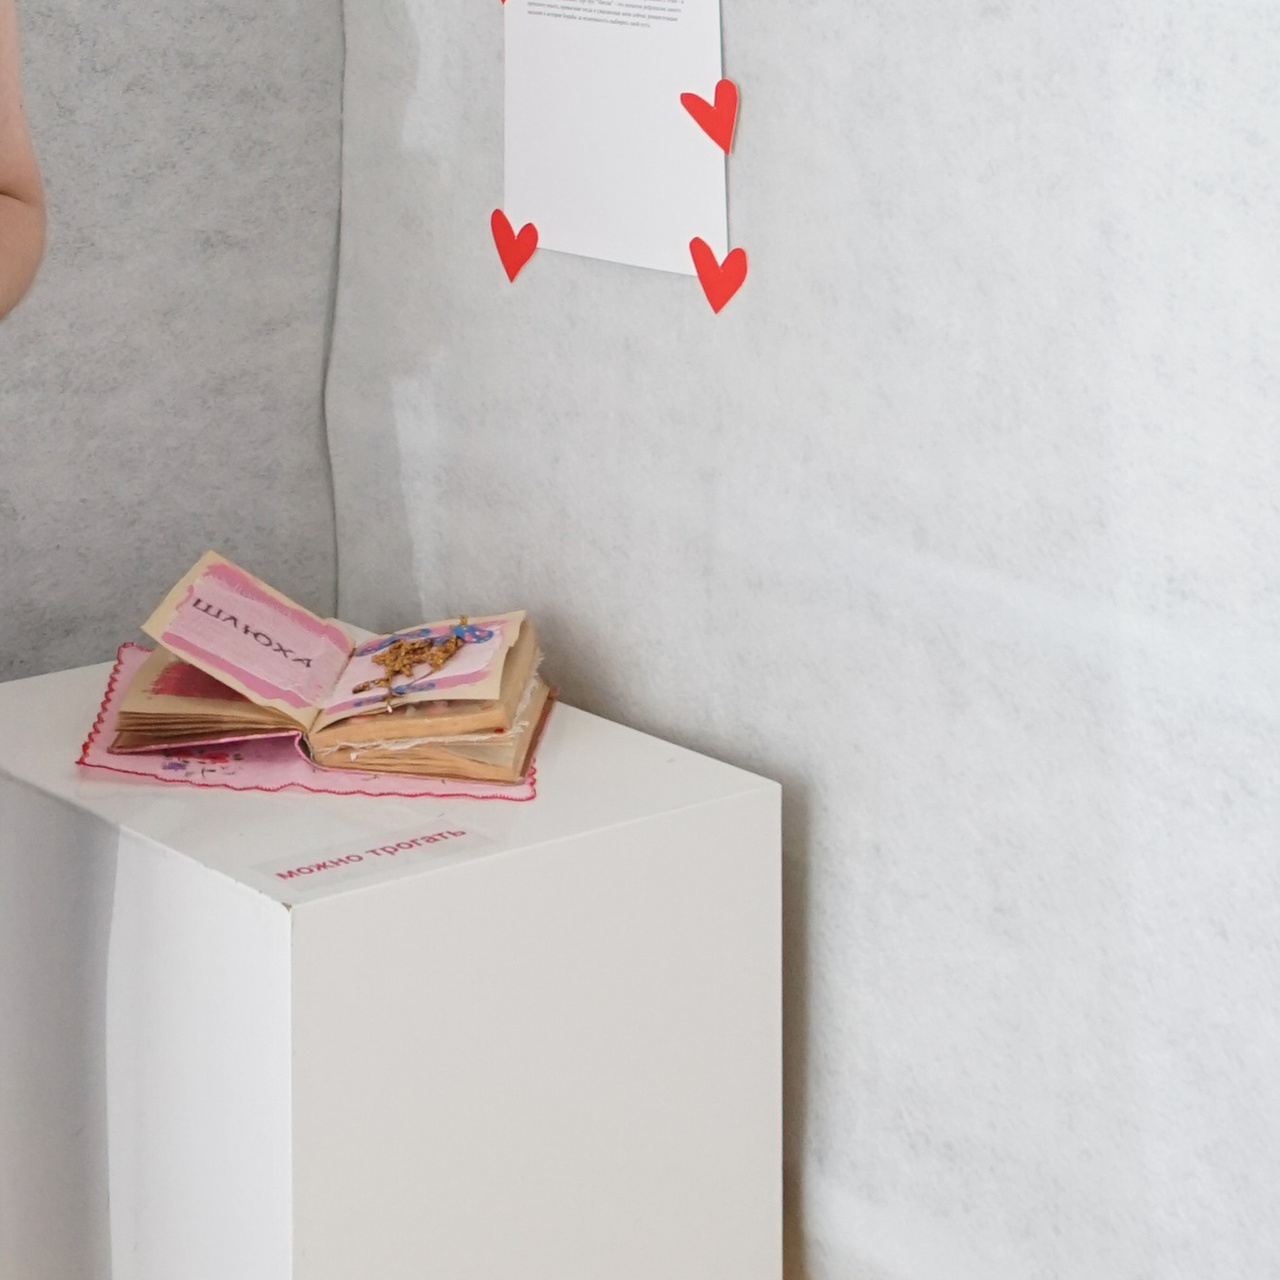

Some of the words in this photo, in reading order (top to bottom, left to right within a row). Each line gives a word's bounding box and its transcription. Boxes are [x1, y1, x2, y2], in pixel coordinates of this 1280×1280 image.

[191, 598, 314, 668] ШЛЮХА
[276, 854, 363, 880] можно
[365, 830, 467, 855] трогать
